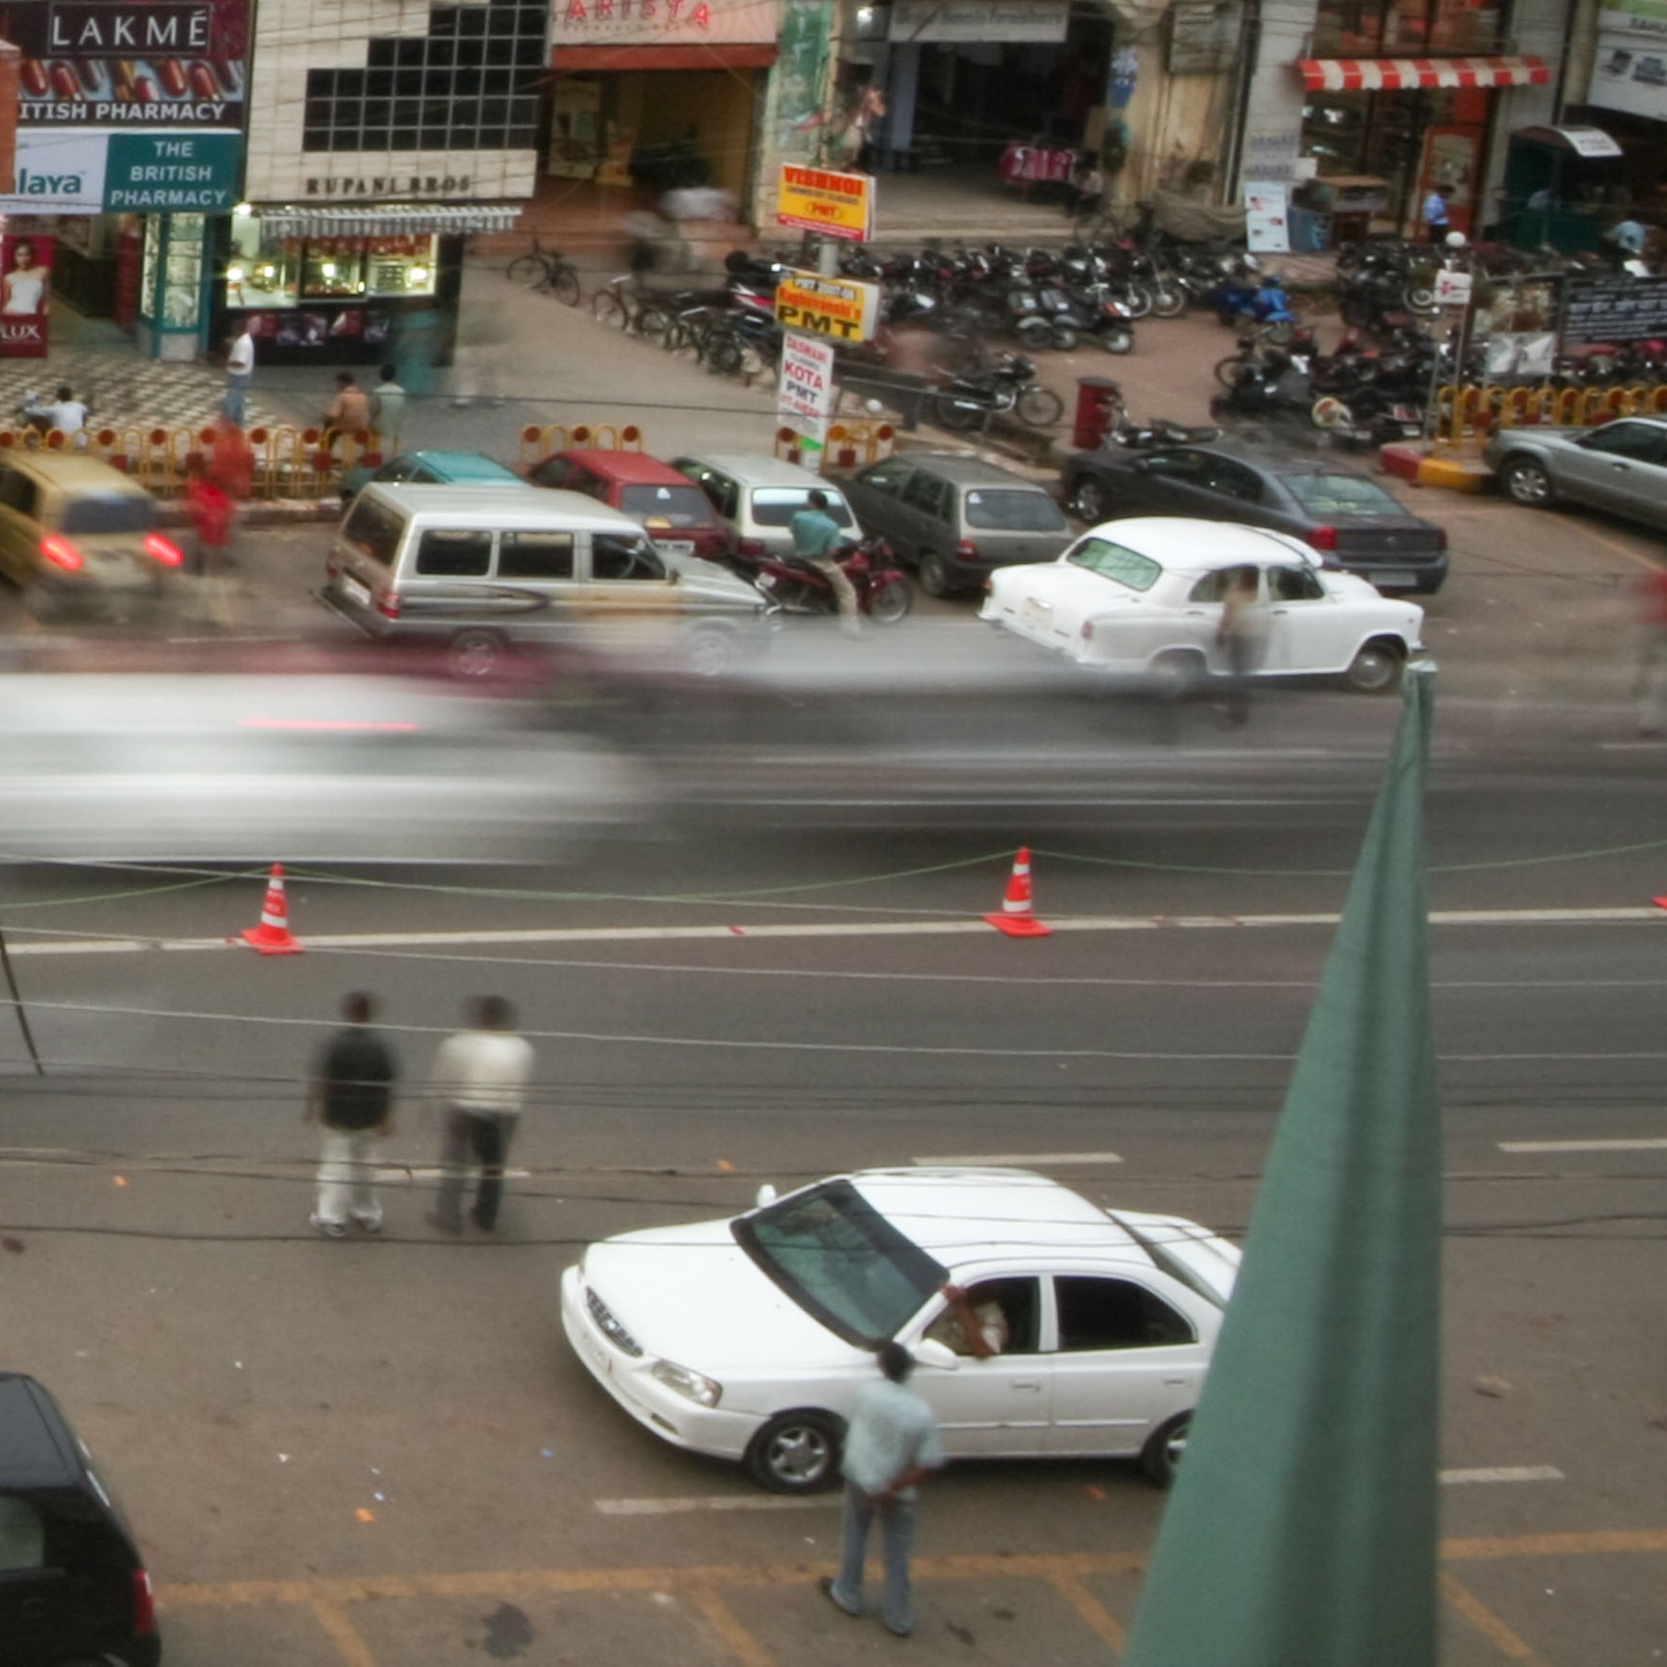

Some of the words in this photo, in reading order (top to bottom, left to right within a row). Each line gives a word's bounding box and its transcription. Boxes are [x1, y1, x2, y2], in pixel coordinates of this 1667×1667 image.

[52, 10, 208, 46] LAKMÉ
[95, 103, 226, 120] PHARMACY
[154, 141, 193, 157] THE
[130, 165, 212, 182] BRITISH
[306, 177, 397, 195] RUPANI
[410, 175, 471, 193] BROS
[110, 190, 227, 205] PHARMACY
[778, 304, 859, 338] PMT
[2, 324, 40, 339] LUX
[784, 360, 823, 391] KOTA
[787, 380, 818, 405] PMT
